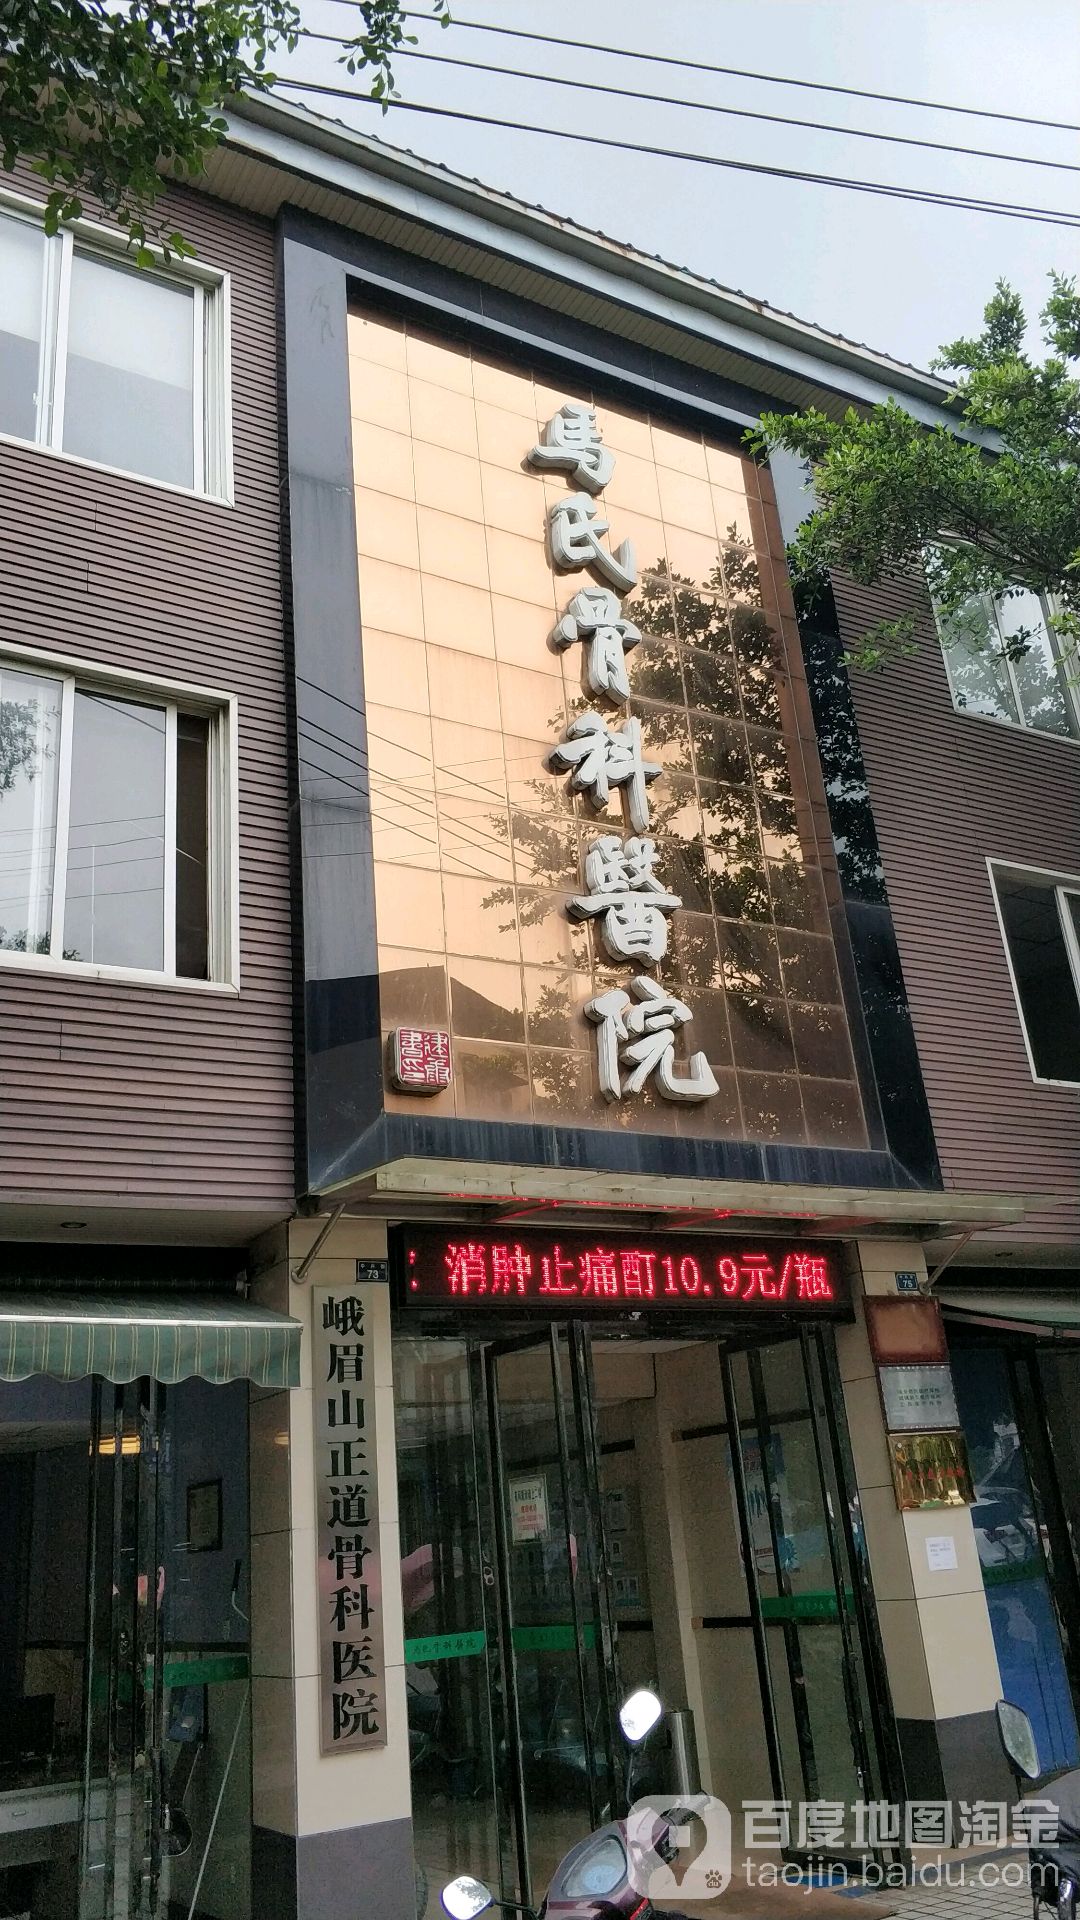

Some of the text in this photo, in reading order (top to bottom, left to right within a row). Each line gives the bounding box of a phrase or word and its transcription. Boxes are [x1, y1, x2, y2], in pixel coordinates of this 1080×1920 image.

[366, 1269, 379, 1279] 73
[902, 1279, 913, 1288] 75
[321, 1295, 380, 1741] 峨眉山正道骨科医院
